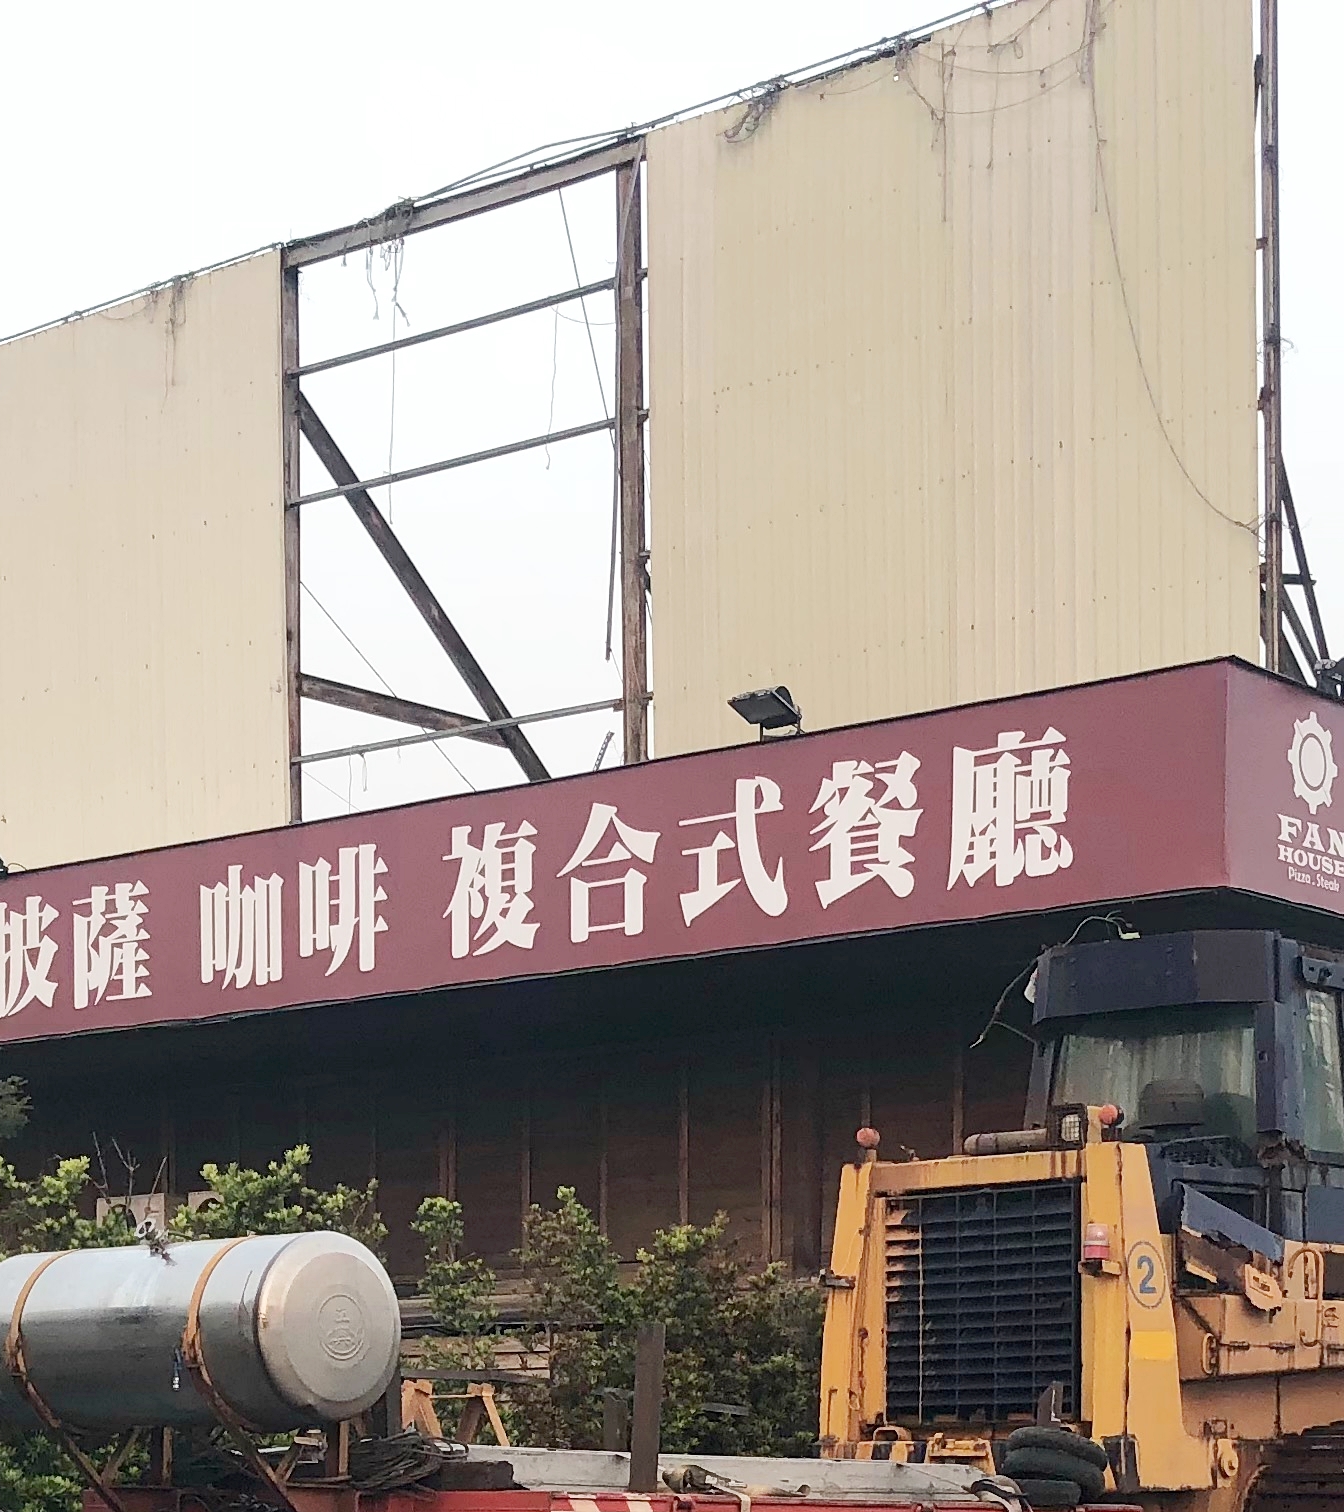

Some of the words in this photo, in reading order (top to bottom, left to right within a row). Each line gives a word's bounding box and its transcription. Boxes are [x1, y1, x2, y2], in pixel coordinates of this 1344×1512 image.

[199, 843, 388, 990] 咖啡
[442, 727, 1074, 959] 複合式餐廳
[1137, 1255, 1157, 1294] 2
